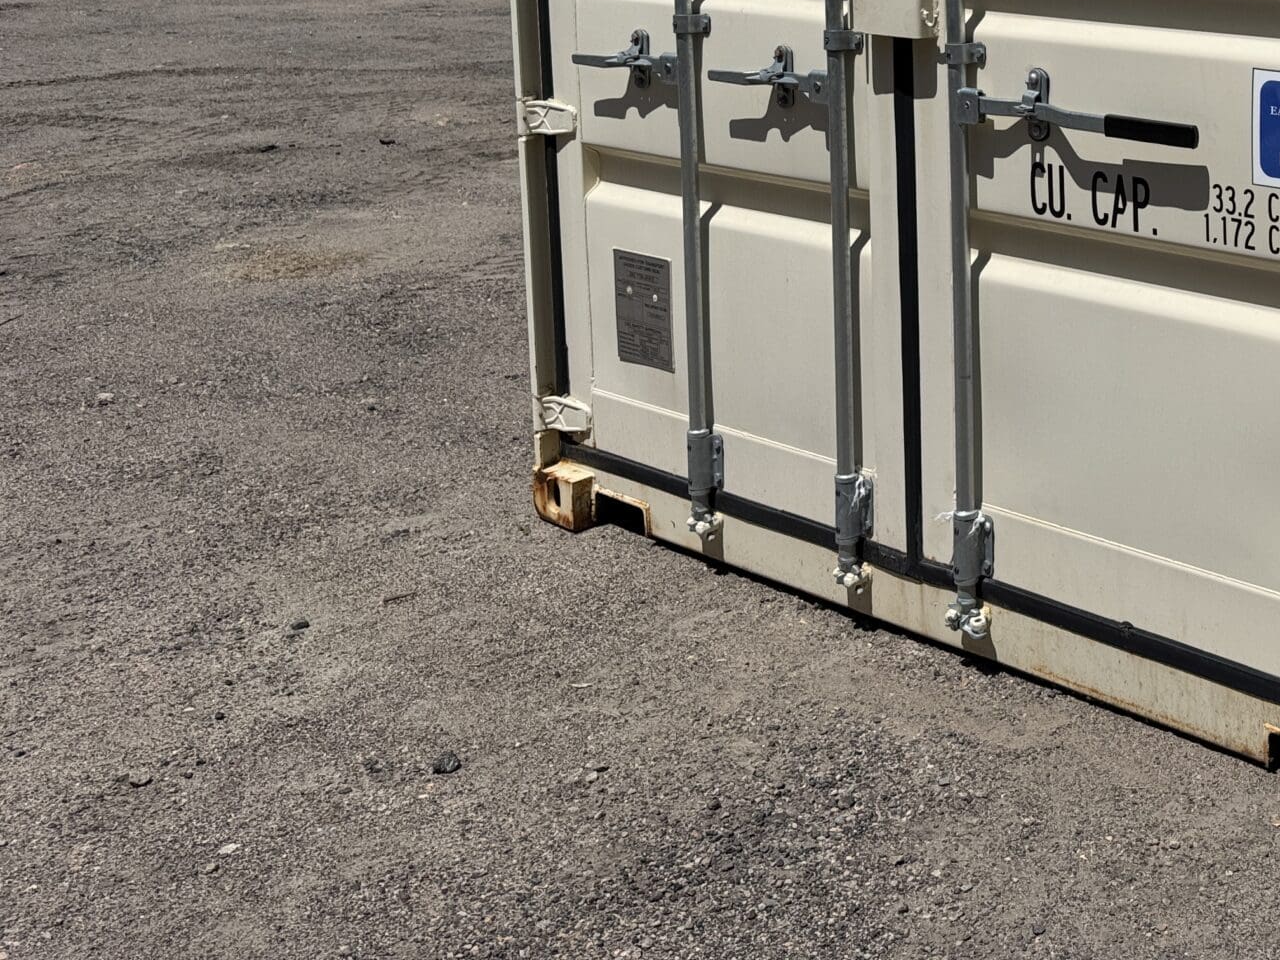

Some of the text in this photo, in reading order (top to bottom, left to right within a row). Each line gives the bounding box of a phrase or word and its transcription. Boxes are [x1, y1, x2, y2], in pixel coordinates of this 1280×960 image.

[1030, 161, 1159, 236] CU. CAP.
[1211, 183, 1255, 218] 33.2
[1203, 213, 1256, 250] 1,172
